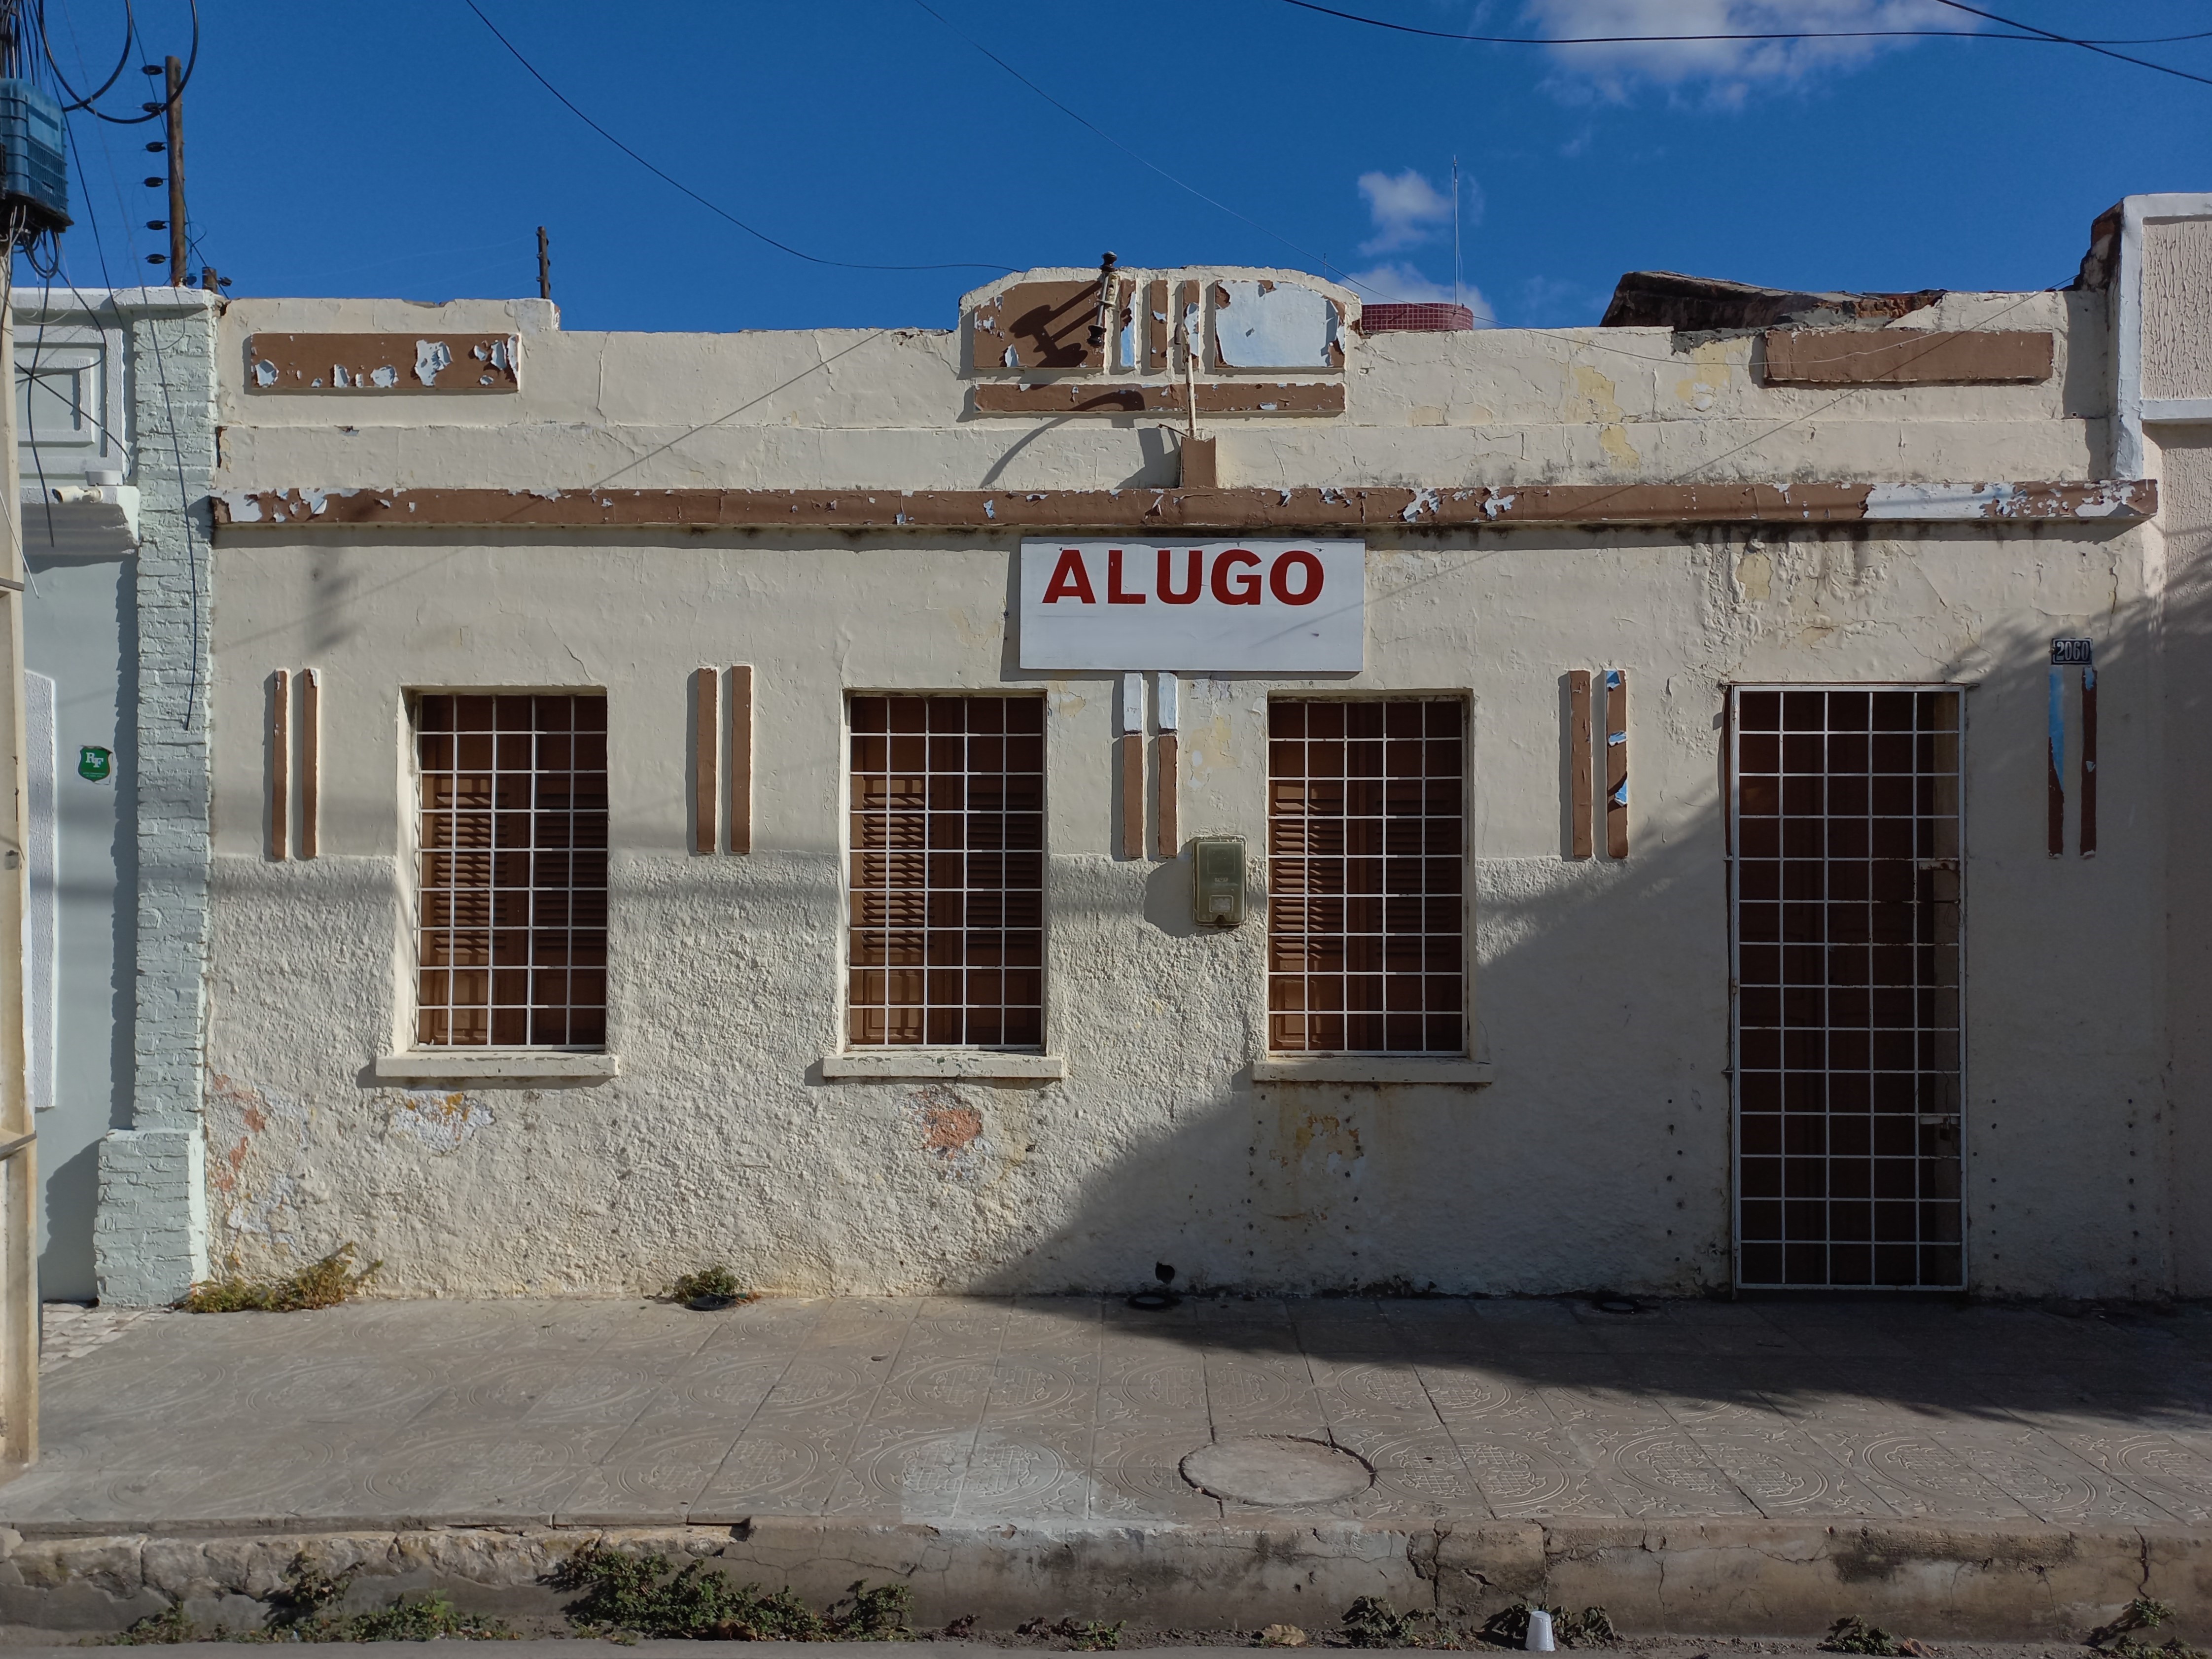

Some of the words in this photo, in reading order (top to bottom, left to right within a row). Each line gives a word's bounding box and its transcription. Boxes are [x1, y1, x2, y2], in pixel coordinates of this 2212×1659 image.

[1042, 549, 1324, 605] ALUGO
[2056, 641, 2089, 660] 2060
[85, 752, 104, 768] RF
